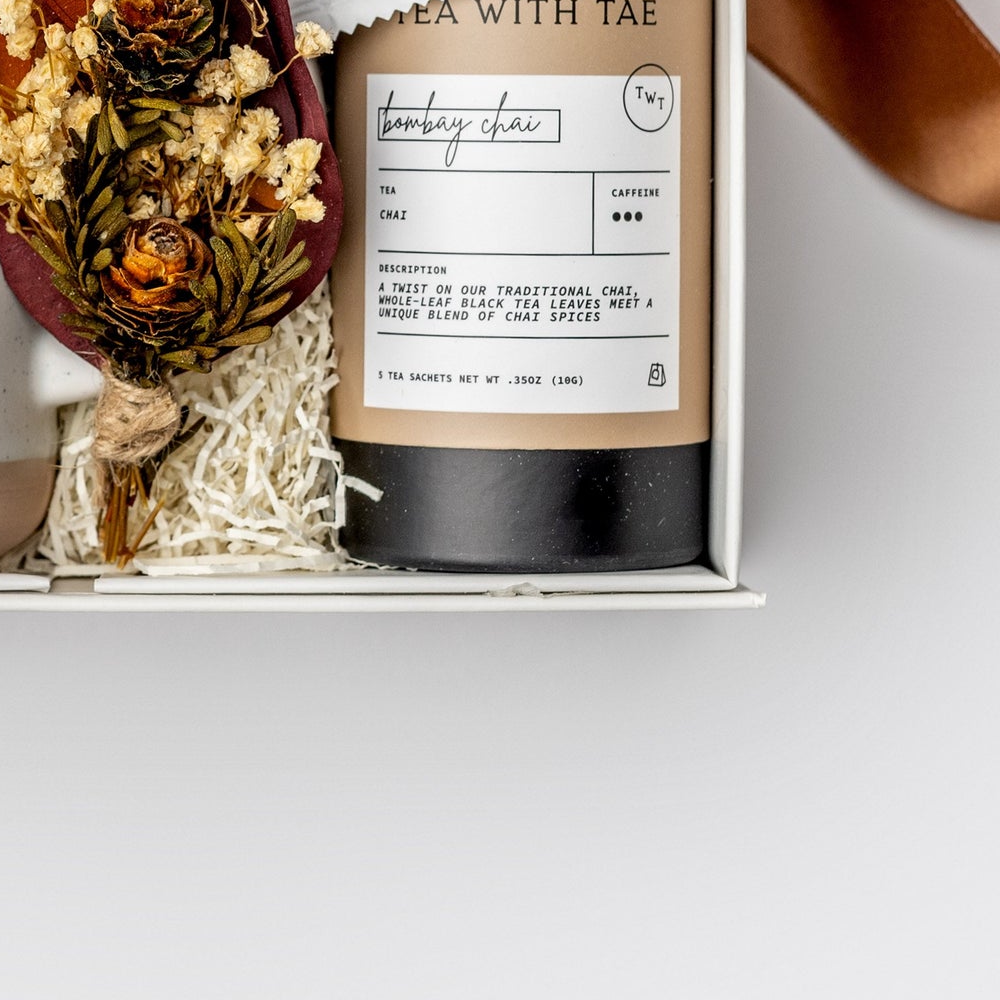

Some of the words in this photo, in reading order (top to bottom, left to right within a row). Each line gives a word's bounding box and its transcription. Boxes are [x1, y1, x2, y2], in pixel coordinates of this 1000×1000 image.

[382, 90, 472, 168] bombay
[481, 92, 541, 142] chai
[379, 185, 396, 195] TEA
[611, 188, 660, 198] CAFFEINE
[379, 209, 407, 221] CHAI
[378, 263, 447, 275] DESCRIPTION
[378, 282, 385, 292] A
[392, 282, 428, 294] TWIST
[435, 284, 453, 295] ON
[460, 285, 487, 296] OUR
[497, 285, 592, 297] TRADITIONAL
[601, 285, 638, 298] CHAI,
[378, 294, 452, 308] WHOLE-LEAF
[460, 297, 505, 309] BLACK
[514, 298, 540, 309] TEA
[550, 298, 601, 310] LEAVES
[609, 298, 640, 309] MEET
[645, 297, 653, 308] A
[378, 307, 420, 321] UNIQUE
[427, 309, 469, 321] BLEND
[478, 310, 496, 322] OF
[505, 311, 540, 322] CHAI
[550, 311, 601, 322] SPICES
[378, 370, 383, 380] 5
[387, 371, 404, 381] TEA
[409, 372, 452, 383] SACHETS
[459, 374, 479, 384] NET
[485, 375, 500, 384] WT
[552, 375, 583, 387] (10G)
